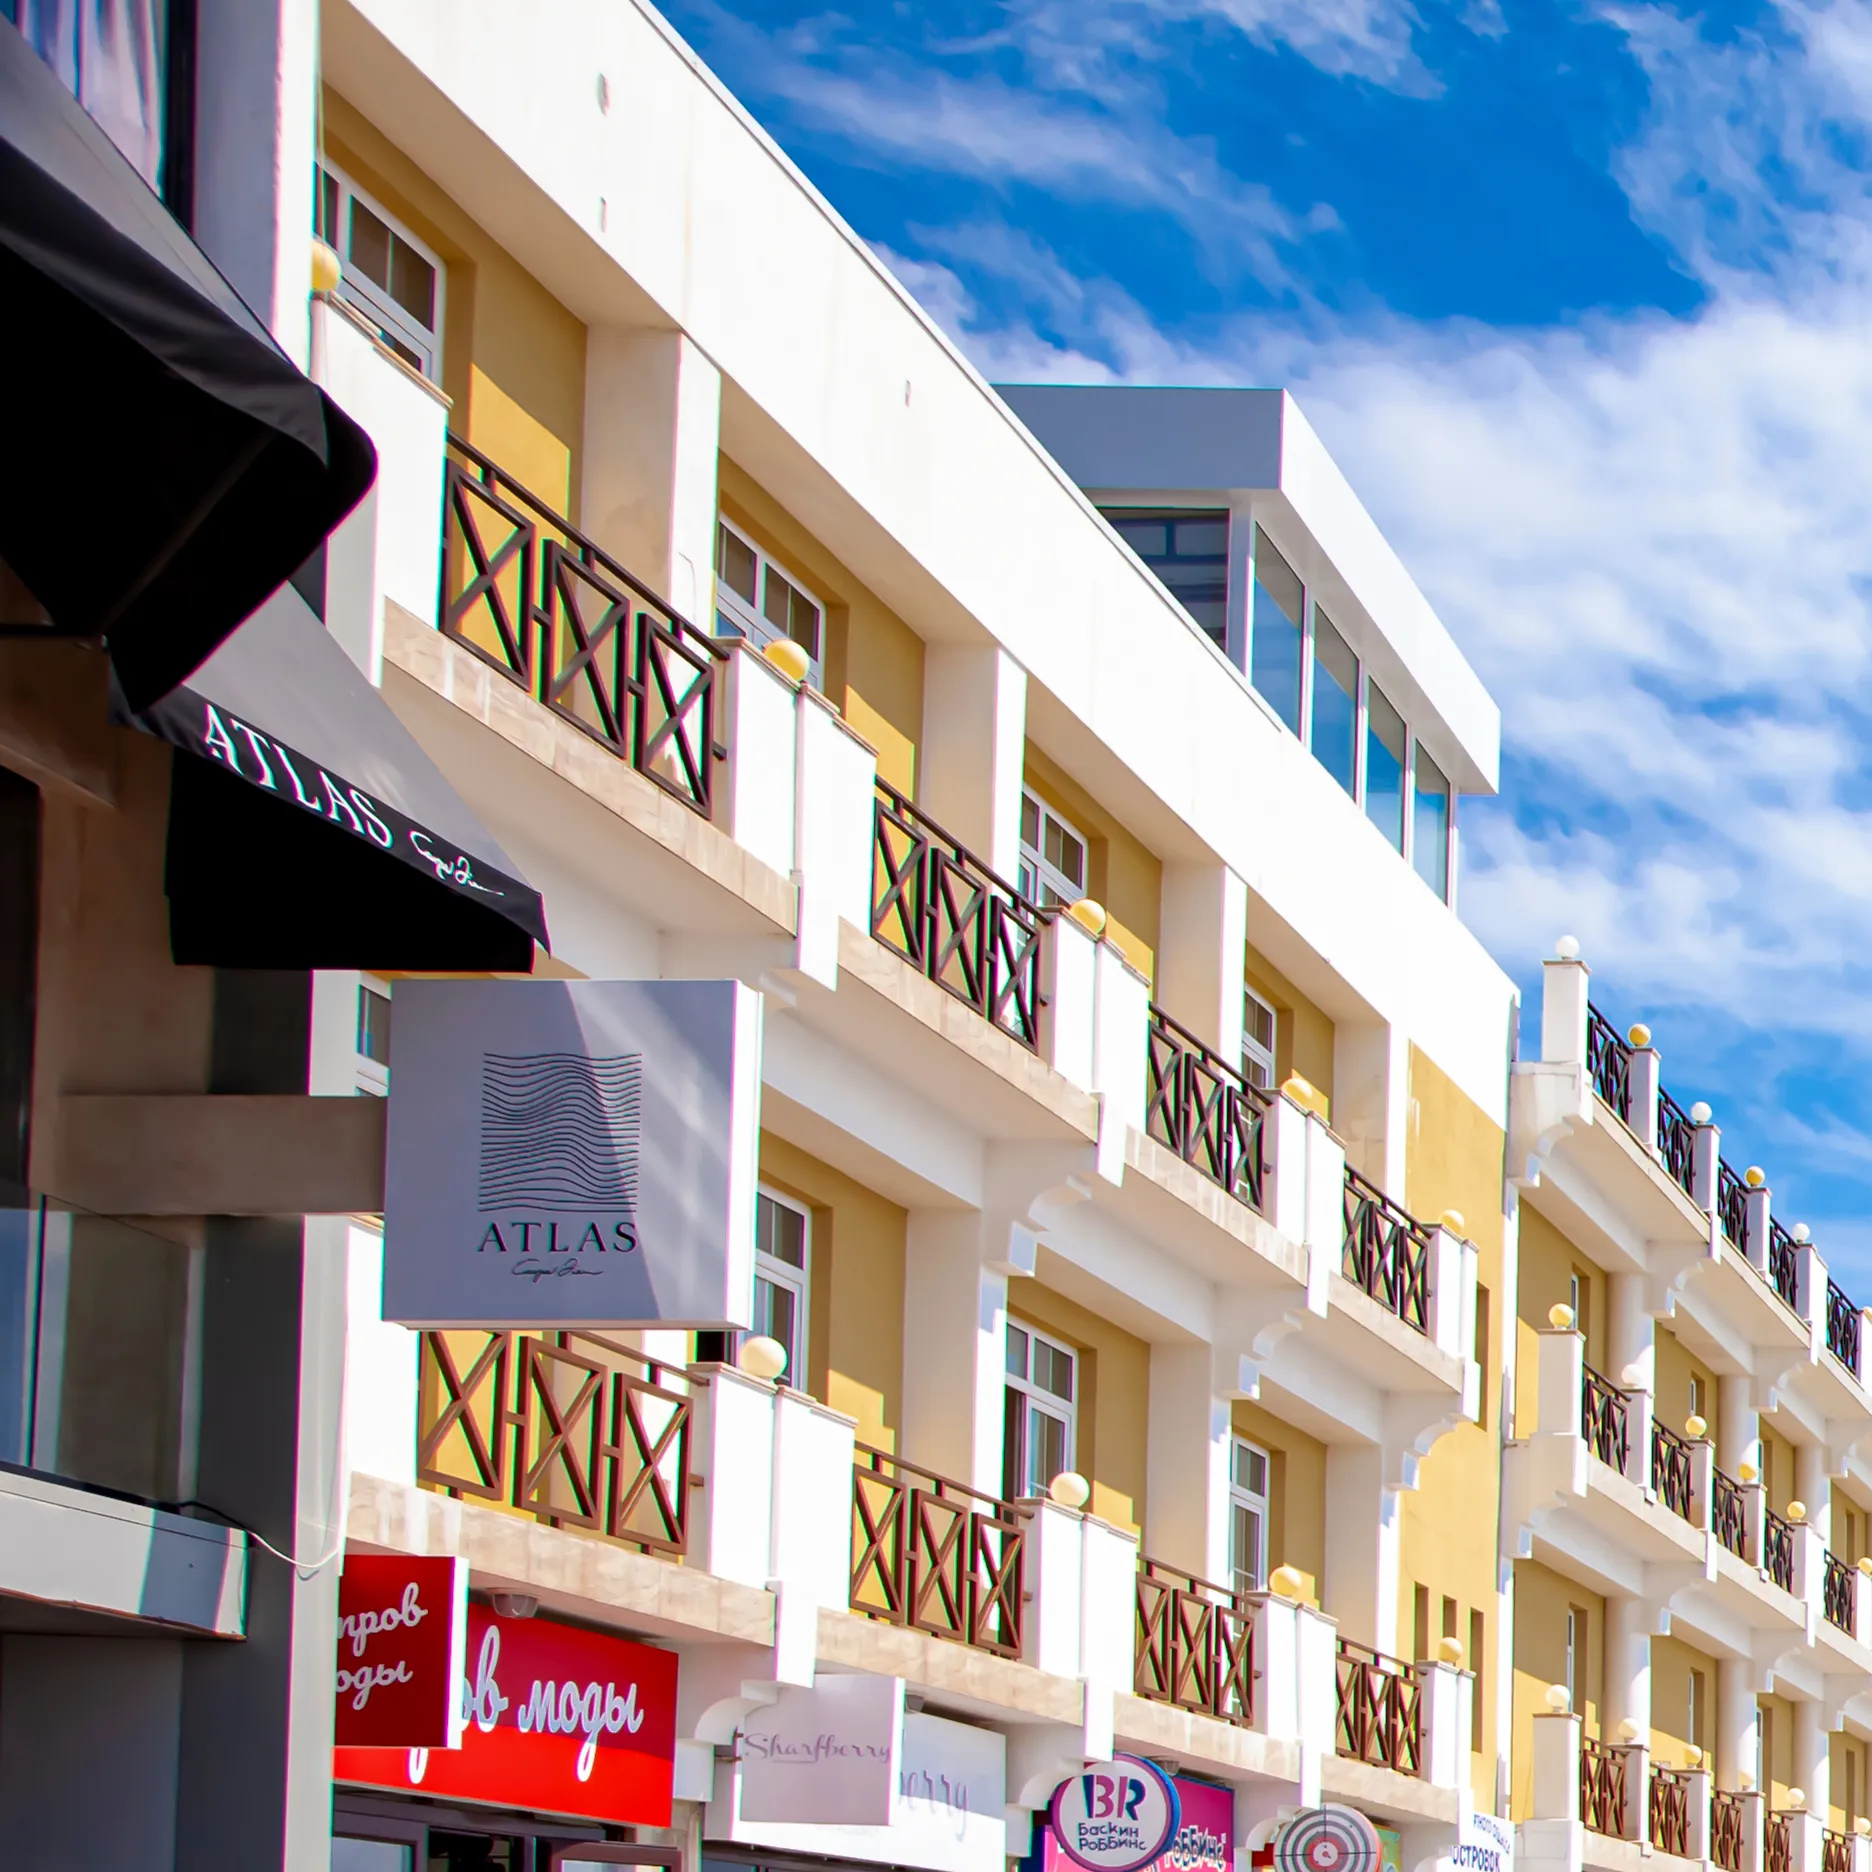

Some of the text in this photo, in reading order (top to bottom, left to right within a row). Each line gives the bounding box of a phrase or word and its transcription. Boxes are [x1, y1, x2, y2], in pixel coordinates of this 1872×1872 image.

[204, 703, 394, 849] ATLAS
[477, 1221, 638, 1253] ATLAS
[336, 1581, 428, 1657] тров
[336, 1660, 414, 1710] оды
[517, 1679, 644, 1782] моды
[1081, 1773, 1147, 1821] BR
